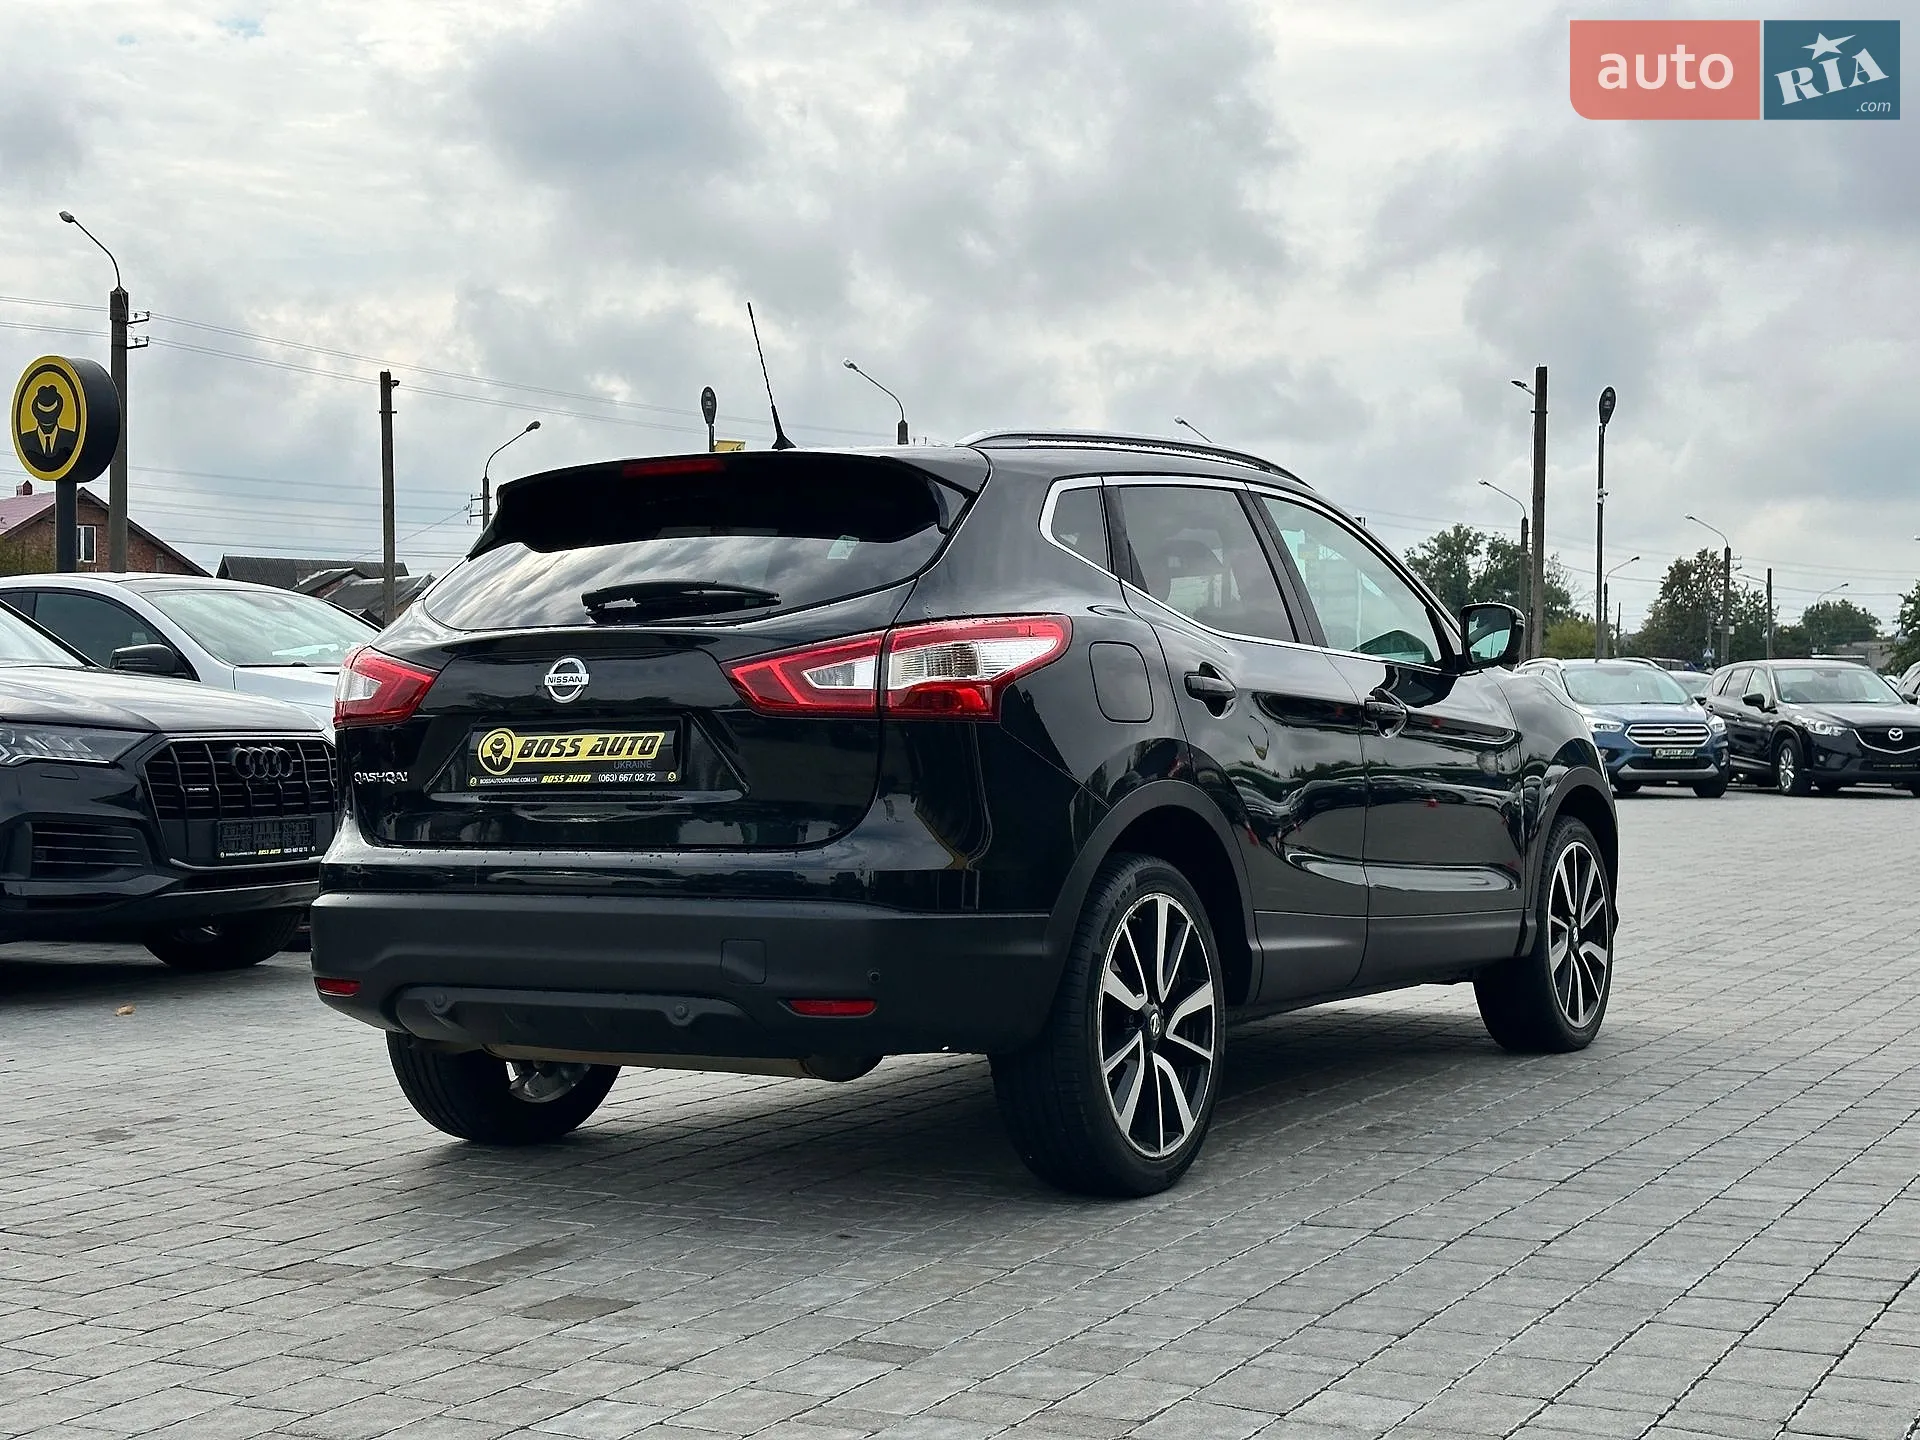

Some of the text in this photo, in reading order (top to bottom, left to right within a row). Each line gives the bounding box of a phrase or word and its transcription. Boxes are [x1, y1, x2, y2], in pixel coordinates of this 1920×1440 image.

[547, 675, 583, 684] NISSAN
[517, 736, 659, 758] BOSS AUTO
[613, 760, 652, 769] UKRAINE
[541, 775, 565, 784] BOSS
[566, 774, 591, 783] AUTO
[598, 773, 617, 783] (063)
[618, 773, 633, 782] 667
[634, 773, 644, 782] 02
[645, 773, 656, 782] 72
